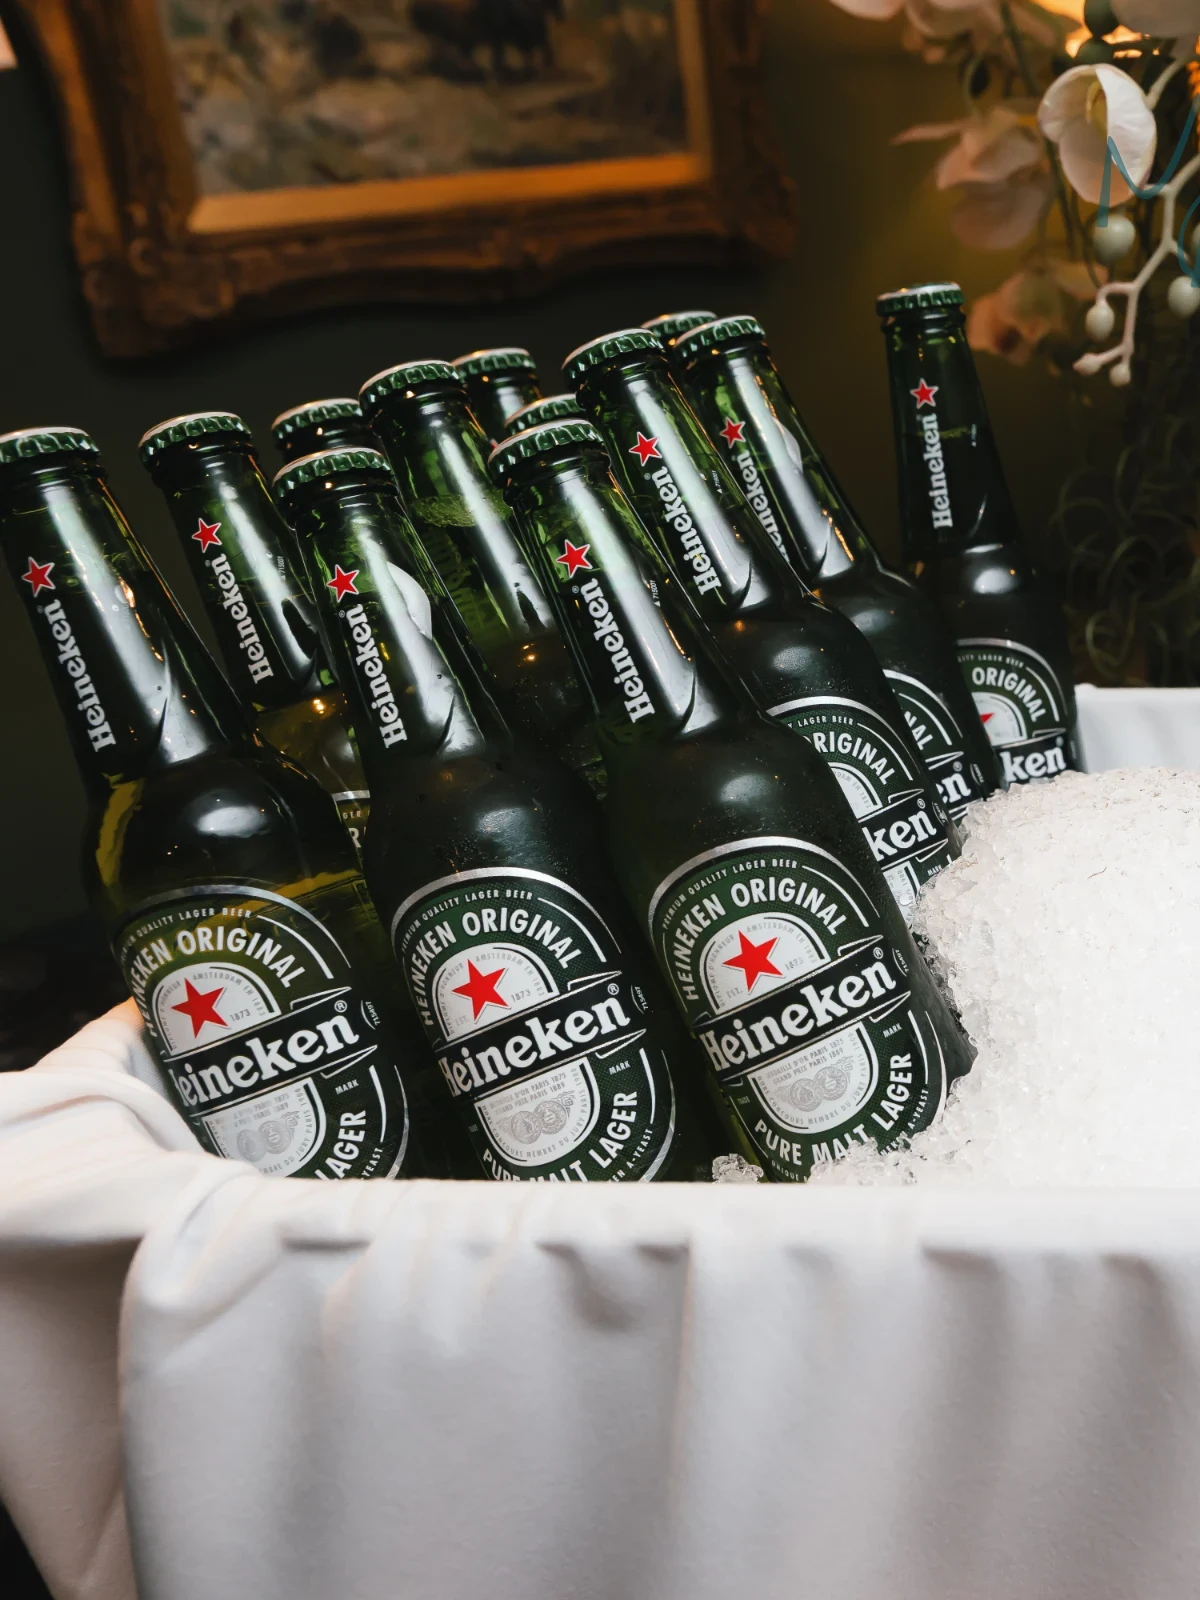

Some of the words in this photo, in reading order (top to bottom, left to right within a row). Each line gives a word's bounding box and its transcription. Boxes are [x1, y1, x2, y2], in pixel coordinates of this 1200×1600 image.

[922, 413, 953, 529] Heineken
[651, 466, 721, 595] Heineken
[211, 553, 274, 684] Heineken
[43, 599, 117, 752] Heineken
[346, 603, 407, 748] Heineken
[581, 578, 655, 723] Heineken
[798, 715, 827, 728] LAGER
[832, 715, 854, 726] BEER
[972, 667, 1046, 722] ORIGINAL
[803, 731, 895, 785] RIGINAL
[342, 810, 361, 820] GER
[422, 896, 460, 920] QUALITY
[465, 889, 500, 903] LAGER
[505, 889, 533, 900] BEER
[688, 869, 728, 895] QUALITY
[732, 859, 766, 874] LAGER
[772, 858, 797, 869] BEER
[136, 915, 174, 937] QUALITY
[179, 908, 215, 920] LAGER
[222, 908, 252, 918] BEER
[673, 893, 727, 1000] HEINEKEN
[731, 876, 848, 935] ORIGINAL
[177, 926, 306, 988] ORIGINAL
[411, 920, 457, 1026] HEINEKEN
[462, 907, 583, 969] ORIGINAL
[229, 1008, 251, 1022] 1873
[511, 989, 531, 1002] 1873
[700, 960, 897, 1071] Heineken
[883, 1023, 902, 1038] MARK
[335, 1079, 359, 1095] MARK
[609, 1060, 630, 1075] MARK
[589, 1091, 638, 1168] LAGER
[754, 1119, 802, 1166] PURE
[871, 1052, 913, 1131] LAGER
[315, 1110, 366, 1181] LAGER
[627, 1129, 653, 1169] A-YEAST
